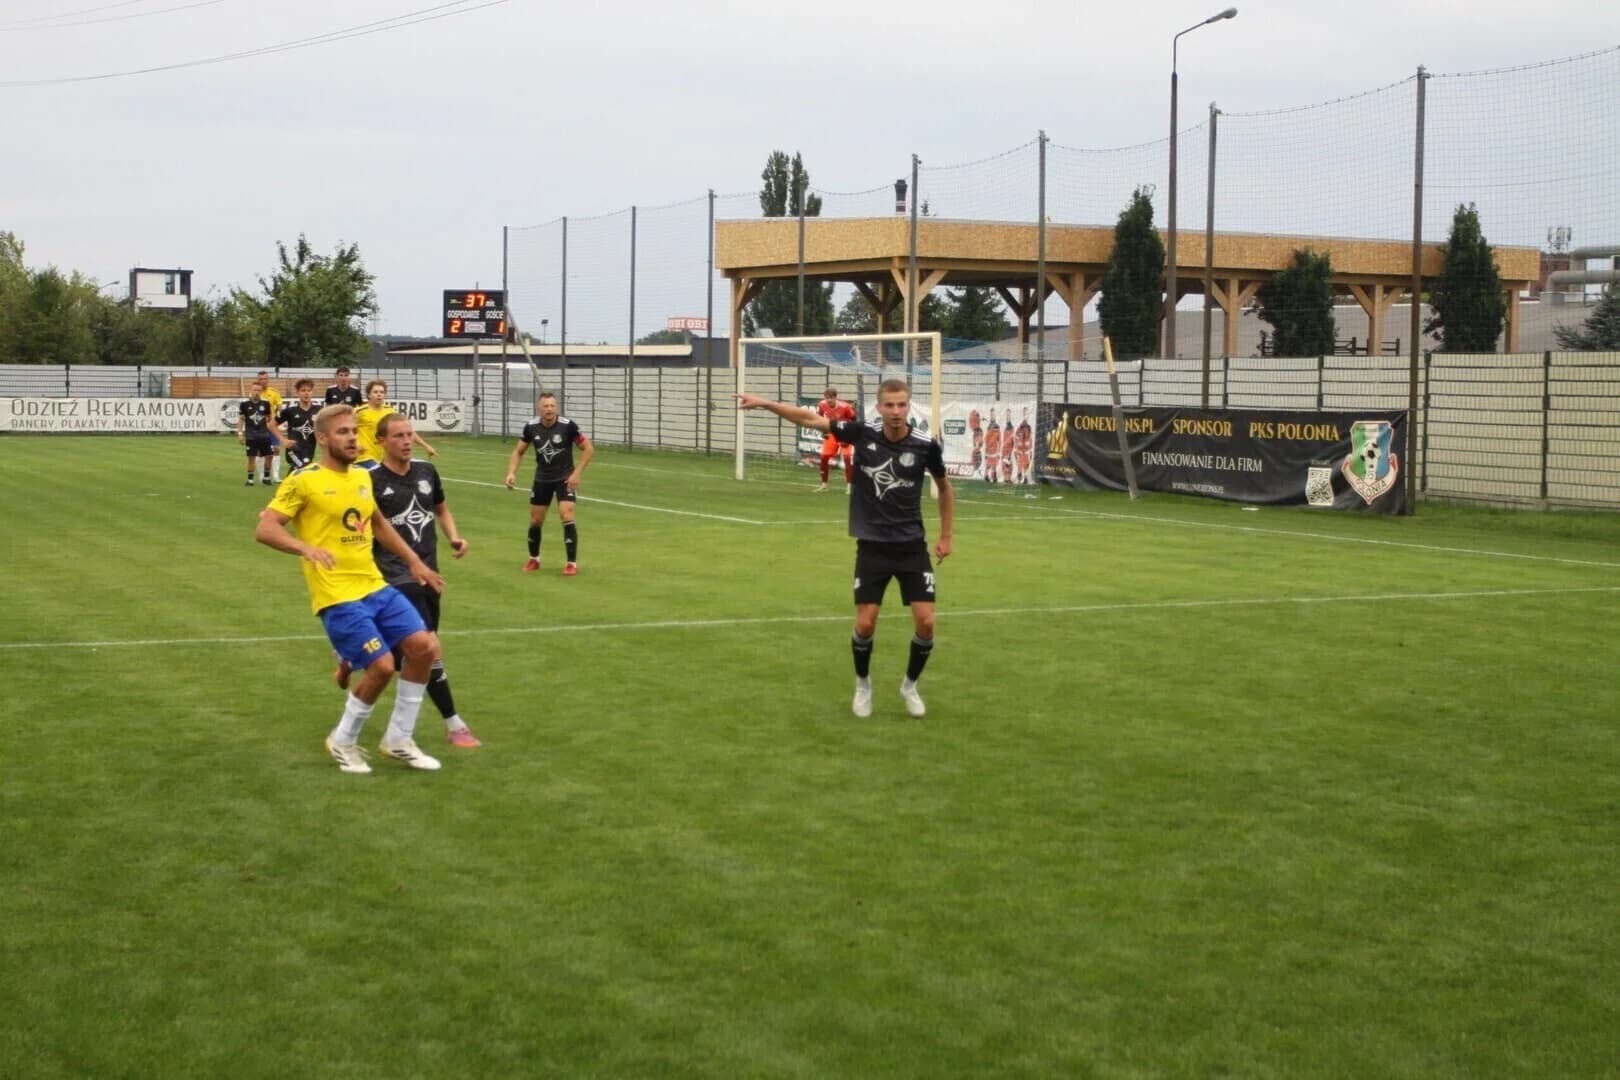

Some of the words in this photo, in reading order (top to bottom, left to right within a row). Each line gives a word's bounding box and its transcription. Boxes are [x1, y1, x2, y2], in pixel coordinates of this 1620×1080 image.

[466, 294, 485, 308] 37
[450, 320, 461, 333] 2
[87, 398, 206, 417] REKLAMOWA
[1074, 415, 1157, 433] CONEXINS.PL
[1172, 419, 1232, 436] SPONSOR
[1249, 422, 1275, 438] PKS
[1277, 423, 1340, 441] POLONIA
[1142, 452, 1214, 469] FINANSOWANIE
[1215, 456, 1236, 471] DLA
[1237, 457, 1263, 472] FIRM
